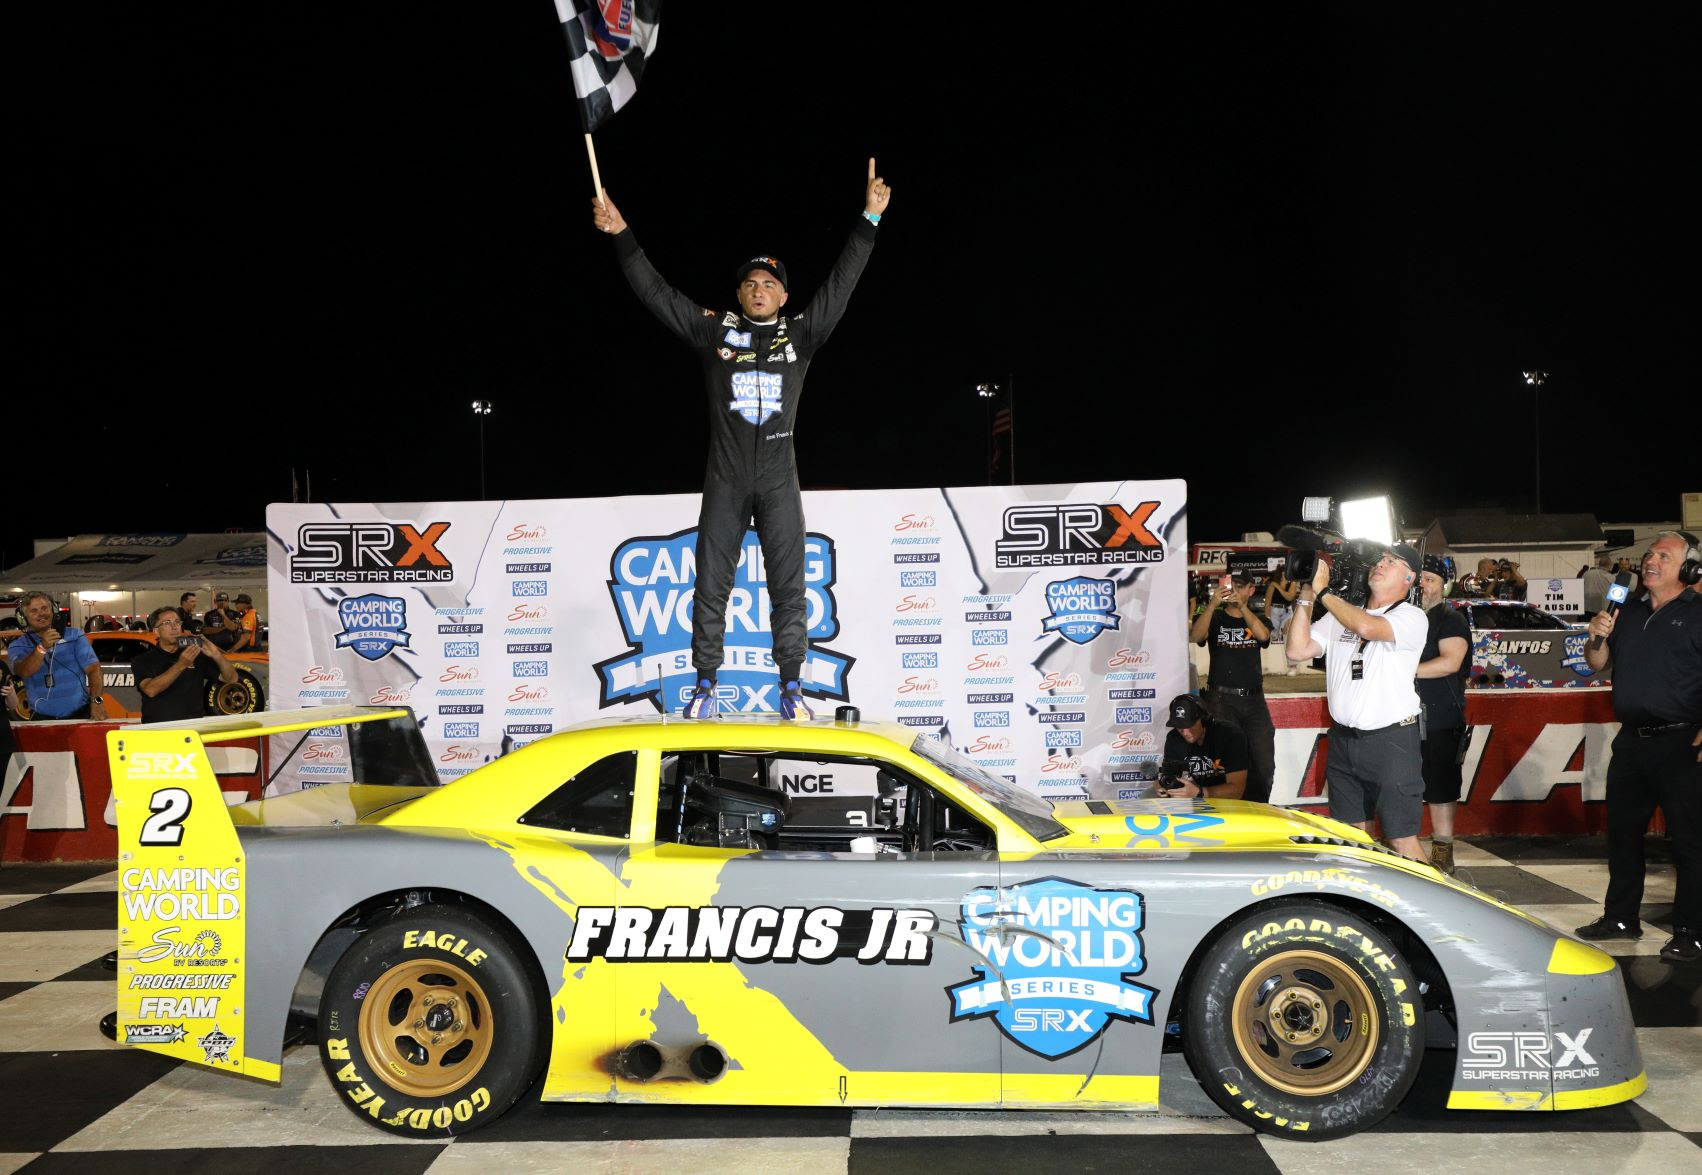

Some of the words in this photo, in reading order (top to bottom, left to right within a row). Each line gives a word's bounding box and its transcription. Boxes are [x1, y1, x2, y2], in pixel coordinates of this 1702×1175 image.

[619, 0, 633, 29] FUE
[732, 374, 782, 387] CAMPING
[733, 386, 782, 398] WORLD
[895, 514, 928, 531] Sun
[997, 501, 1161, 551] SRX
[506, 524, 539, 541] Sun
[292, 522, 451, 567] SRX
[891, 537, 941, 545] PROGRESSIVE
[503, 547, 552, 555] PROGRESSIVE
[997, 553, 1097, 566] SUPERSTAR
[1102, 550, 1162, 563] RACING
[293, 571, 390, 582] SUPERSTAR
[393, 570, 452, 581] RACING
[514, 588, 546, 596] WORLD
[1049, 582, 1112, 596] CAMPING
[342, 600, 402, 613] CAMPING
[896, 595, 929, 612] Sun
[962, 595, 1012, 603] PROGRESSIVE
[1050, 596, 1112, 611] WORLD
[1538, 603, 1579, 611] AUSON
[343, 613, 403, 627] WORLD
[435, 608, 484, 616] PROGRESSIVE
[507, 604, 540, 621] Sun
[892, 618, 942, 626] PROGRESSIVE
[1066, 625, 1097, 634] SRX
[504, 627, 553, 635] PROGRESSIVE
[358, 642, 388, 650] SRX
[446, 649, 478, 657] WORLD
[1488, 639, 1551, 655] SANTOS
[674, 651, 776, 670] SIES
[967, 653, 1000, 671] Sun
[1109, 649, 1143, 667] Sun
[103, 673, 135, 687] WAR
[303, 667, 335, 683] Sun
[440, 666, 472, 682] Sun
[514, 668, 546, 676] WORLD
[1106, 672, 1157, 680] PROGRESSIVE
[897, 677, 931, 693] Sun
[1039, 673, 1072, 690] Sun
[298, 690, 348, 698] PROGRESSIVE
[370, 687, 403, 704] Sun
[508, 685, 541, 702] Sun
[1035, 696, 1086, 704] PROGRESSIVE
[504, 708, 554, 716] PROGRESSIVE
[970, 735, 1002, 753] Sun
[1112, 731, 1145, 749] Sun
[303, 744, 335, 759] Sun
[441, 746, 473, 761] Sun
[128, 752, 197, 773] SRX
[298, 766, 348, 774] PROGRESSIVE
[974, 758, 1017, 766] OGRESSIVE
[1041, 755, 1074, 772] Sun
[782, 774, 834, 793] NGE
[1038, 778, 1088, 787] PROGRESSIVE
[1120, 790, 1142, 798] CAMP
[139, 787, 192, 847] 2
[122, 867, 240, 892] CAMPING
[124, 893, 240, 921] WORLD
[967, 894, 1136, 928] CAMPING
[566, 906, 845, 961] FRANCIS
[858, 908, 938, 964] JR
[136, 926, 208, 963] Sun
[403, 930, 488, 967] EAGLE
[129, 974, 235, 990] PROGRESSIVE
[1010, 981, 1095, 996] SERIES
[139, 997, 220, 1019] FRAM
[1010, 1008, 1094, 1032] SRX
[126, 1025, 174, 1036] WCRA
[1462, 1028, 1598, 1068] SRX
[1462, 1070, 1549, 1080] SUPERSTAR
[1553, 1067, 1600, 1080] RACING
[327, 1038, 491, 1130] GOODYEAR
